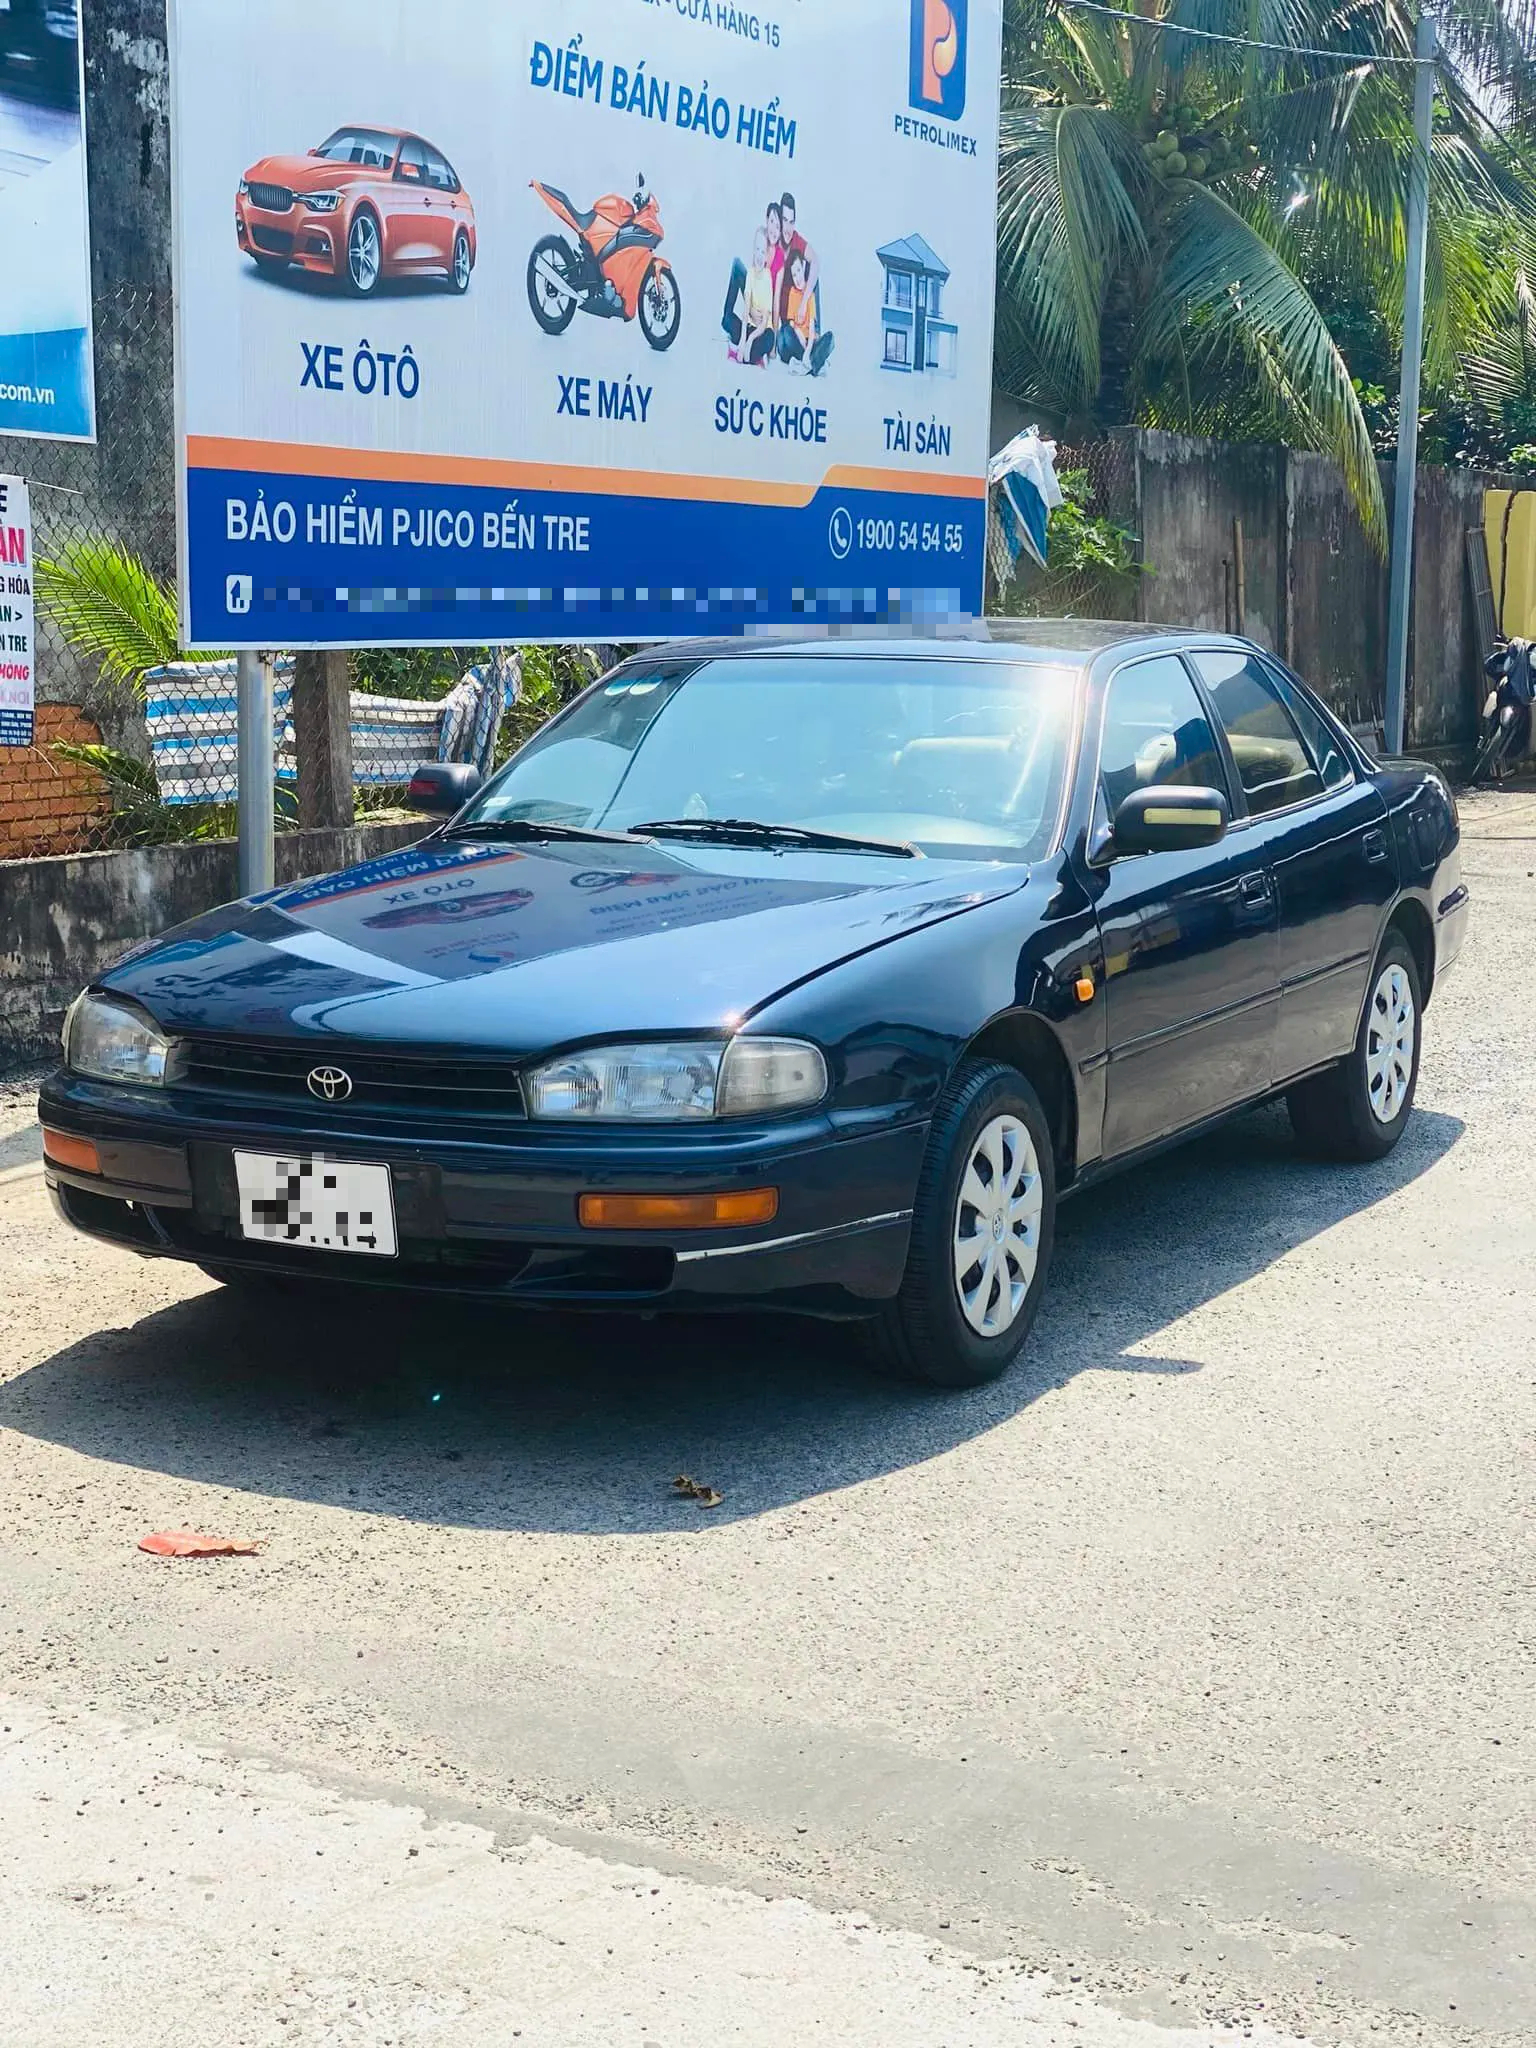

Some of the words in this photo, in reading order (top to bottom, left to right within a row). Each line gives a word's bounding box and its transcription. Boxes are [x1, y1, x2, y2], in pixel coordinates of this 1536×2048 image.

[716, 2, 760, 41] HÀNG
[764, 22, 780, 48] 15
[529, 33, 604, 104] ĐIỂM
[610, 60, 670, 122] BÁN
[676, 80, 730, 140] BẢO
[736, 96, 797, 159] HIỂM
[894, 114, 977, 157] PETROLIMEX
[300, 341, 344, 391] XE
[353, 338, 419, 399] ÔTÔ
[556, 375, 591, 417] XE
[598, 373, 653, 423] MÁY
[715, 389, 764, 437] SỨC
[769, 397, 827, 443] KHỎE
[883, 410, 911, 452] TÀI
[915, 414, 950, 456] SẢN
[226, 488, 297, 543] BẢO
[306, 488, 383, 546] HIỂM
[392, 508, 475, 548] PJICO
[482, 498, 535, 550] BẾN
[543, 515, 591, 552] TRE
[857, 518, 895, 550] 1900
[899, 521, 918, 551] 54
[921, 523, 941, 552] 54
[944, 524, 963, 553] 55
[8, 574, 31, 596] HÓA
[8, 634, 28, 653] TRE
